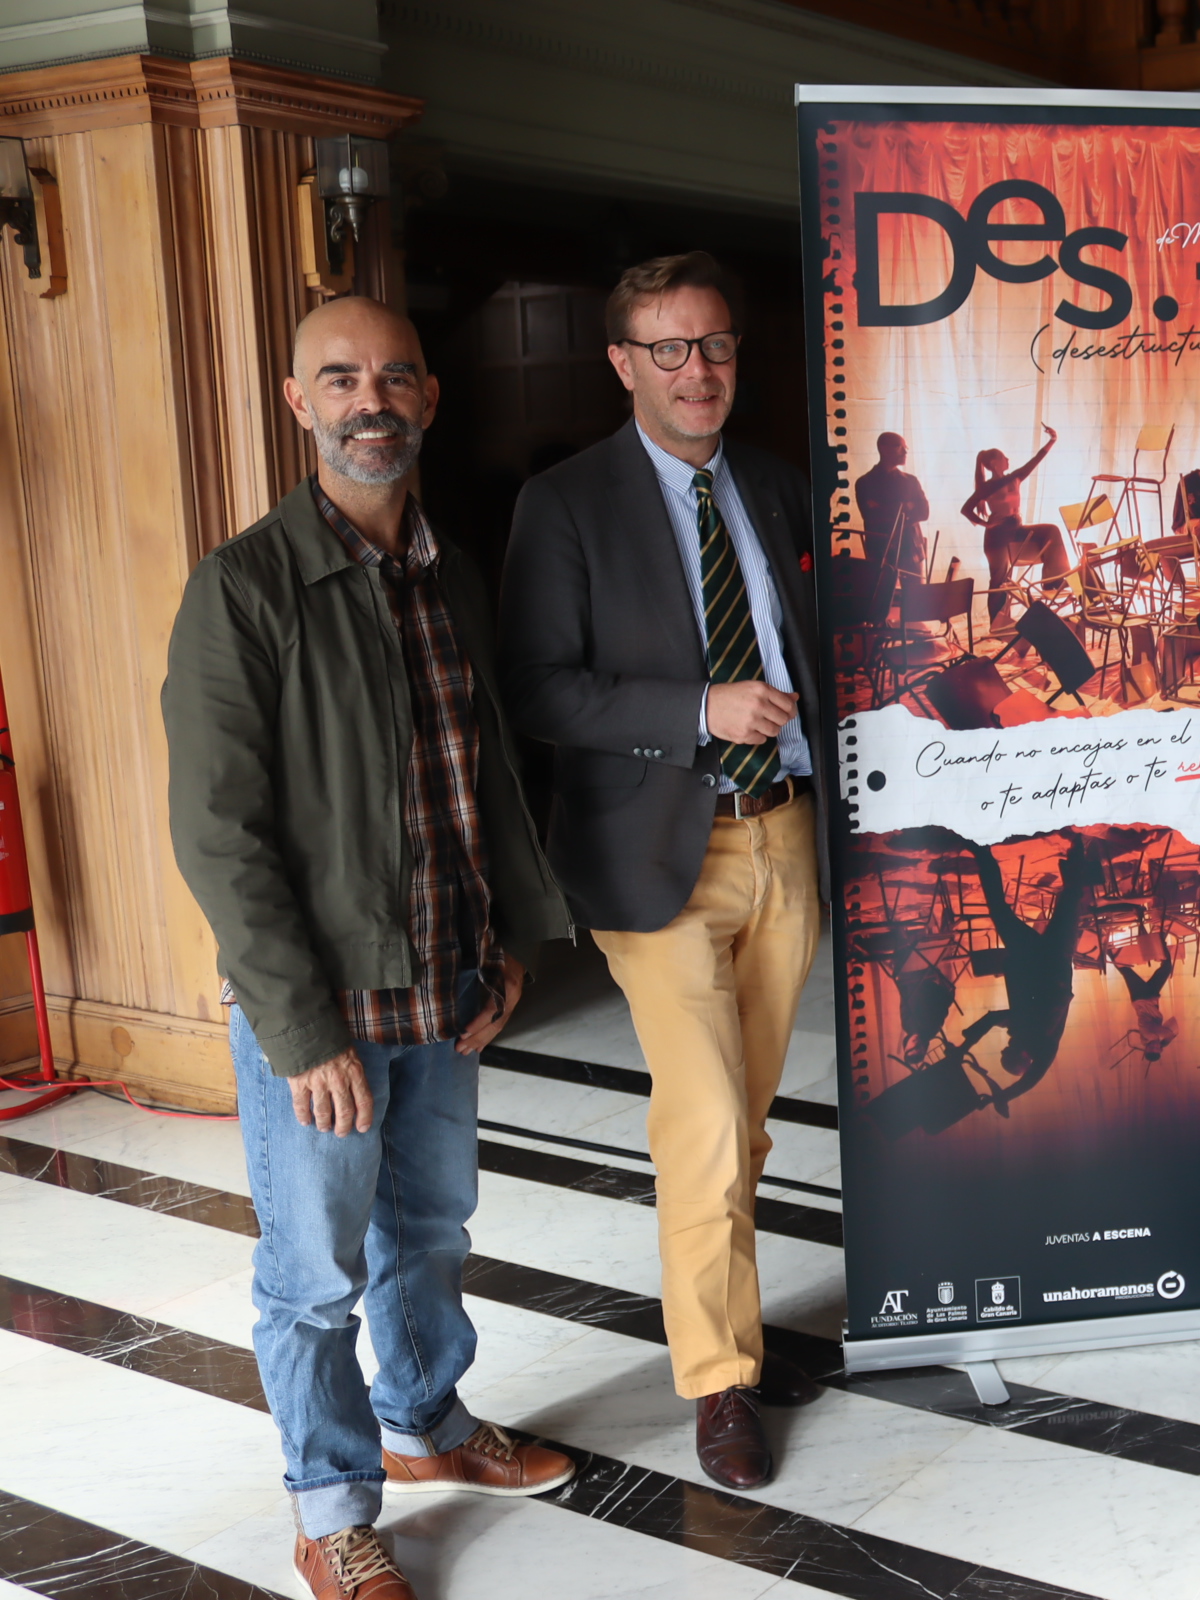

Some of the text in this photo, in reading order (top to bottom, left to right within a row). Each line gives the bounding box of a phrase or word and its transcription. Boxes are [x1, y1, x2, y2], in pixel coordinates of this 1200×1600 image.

[915, 740, 1008, 778] Cuando
[1015, 749, 1042, 760] no
[1050, 738, 1128, 768] encajas
[1136, 737, 1162, 747] en
[1170, 717, 1193, 746] el
[980, 800, 995, 811] o
[1000, 782, 1023, 819] te
[1031, 772, 1117, 810] adaptas
[1126, 774, 1140, 784] o
[1144, 756, 1168, 792] te
[1045, 1227, 1152, 1246] JUVENTAS A ESCENA
[1042, 1283, 1155, 1303] unahoramenos
[871, 1312, 918, 1324] FUNDACIÓN
